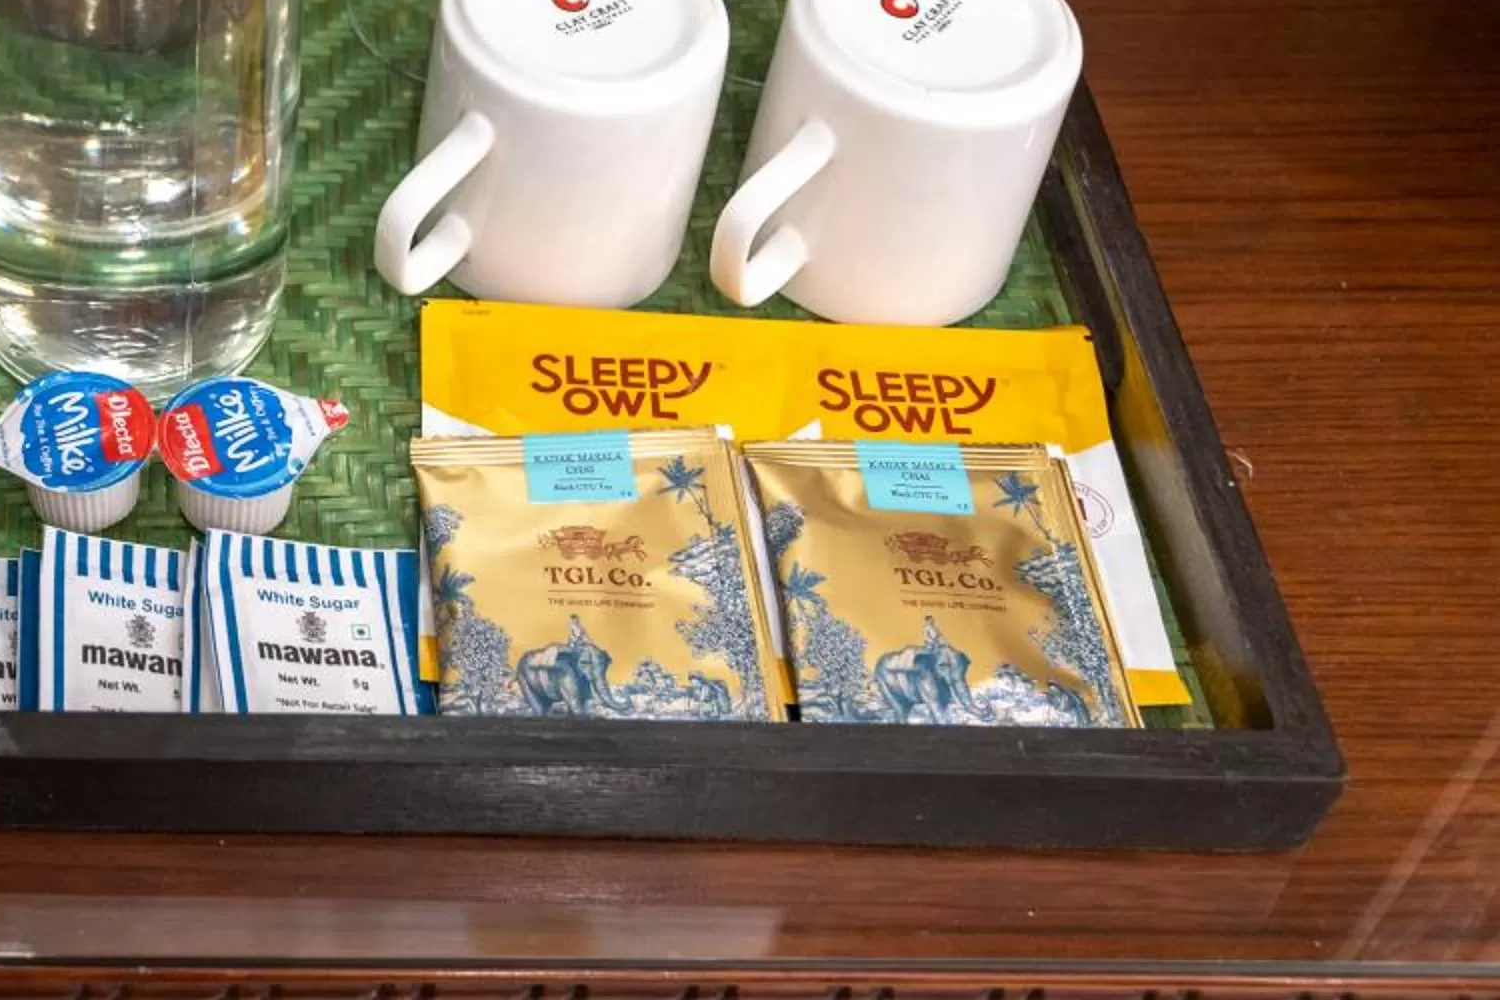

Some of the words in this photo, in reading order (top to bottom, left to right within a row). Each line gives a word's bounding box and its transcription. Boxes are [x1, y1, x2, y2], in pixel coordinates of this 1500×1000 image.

[555, 16, 587, 31] CLAY
[589, 0, 628, 18] CRAFT
[902, 19, 926, 41] CLAY
[531, 354, 712, 399] SLEEPY
[562, 387, 679, 420] OWL
[817, 368, 996, 415] SLEEPY
[854, 403, 972, 435] OWL
[544, 567, 603, 585] TGL
[608, 567, 652, 587] Co.
[894, 567, 954, 587] TGL
[958, 573, 1002, 590] Co.
[88, 589, 137, 610] White
[141, 599, 184, 618] Suga
[257, 588, 304, 607] White
[309, 595, 360, 612] Sugar
[81, 644, 182, 677] mawan
[257, 641, 378, 668] mawana
[98, 679, 119, 691] Net
[278, 672, 299, 685] Net
[302, 675, 320, 687] Wt.
